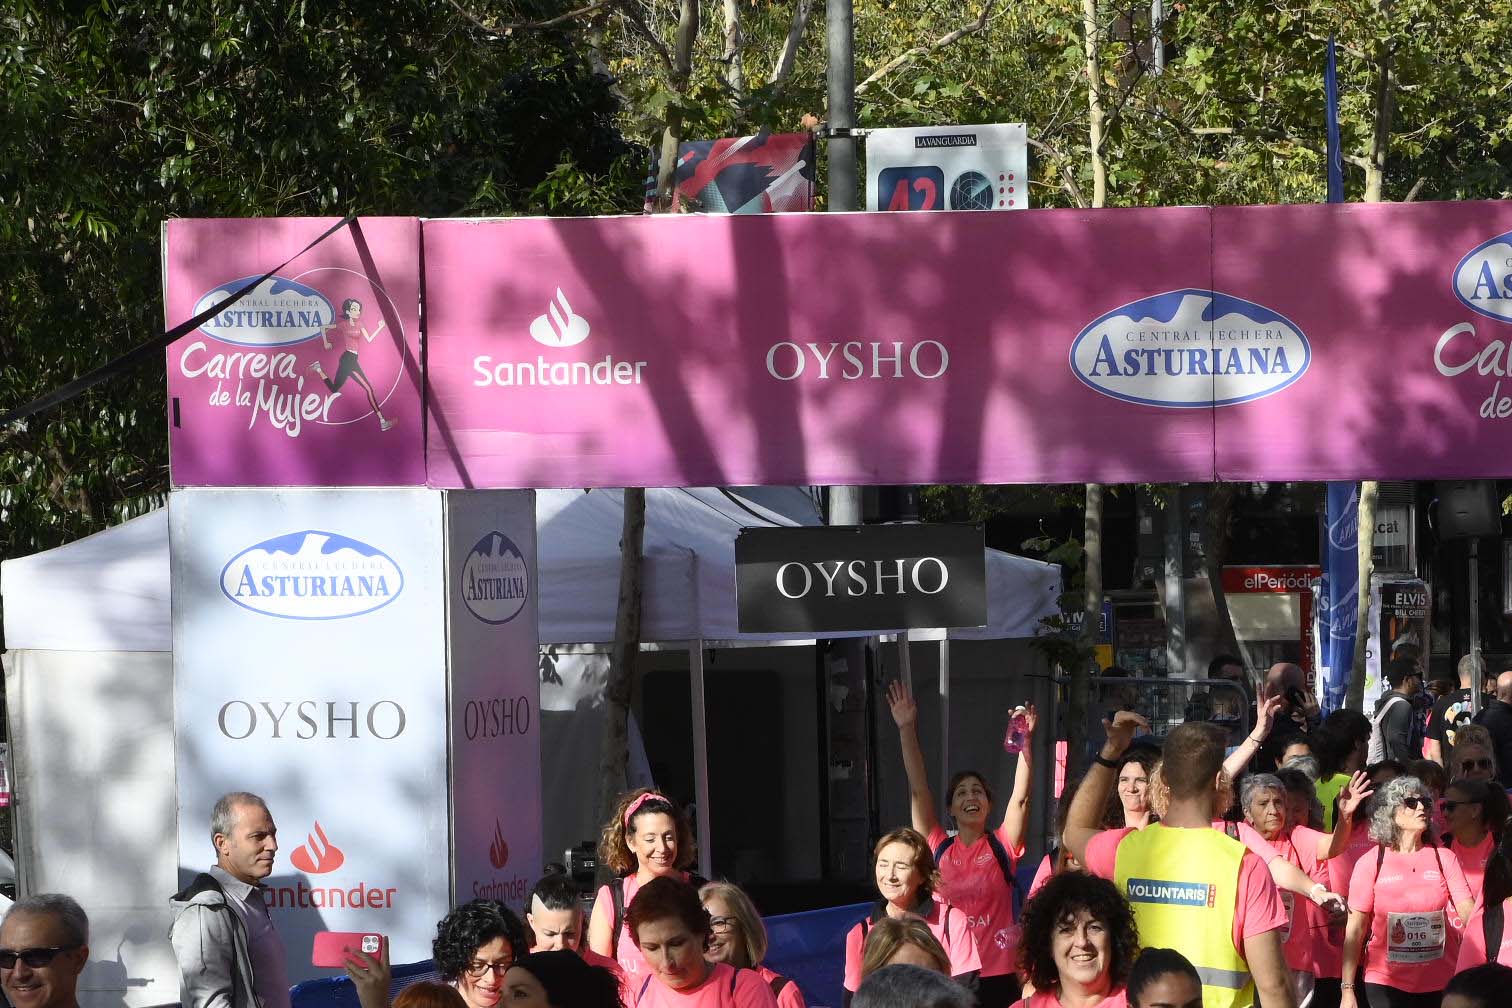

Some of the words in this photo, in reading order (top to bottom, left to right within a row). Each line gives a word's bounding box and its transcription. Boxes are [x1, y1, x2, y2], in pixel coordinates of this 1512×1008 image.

[917, 137, 927, 147] LA
[926, 135, 976, 146] VANGUARDIA
[202, 301, 323, 328] ASTURIANA
[233, 299, 269, 307] ENTRAL
[1126, 329, 1201, 342] CENTRAL
[1209, 329, 1283, 341] LECHERA
[180, 341, 297, 379] Carrera
[473, 354, 648, 386] Santander
[766, 339, 949, 381] OYSHO
[1089, 334, 1292, 377] ASTURIANA
[209, 380, 231, 406] de
[235, 380, 251, 406] la
[249, 375, 342, 438] Mujer
[235, 564, 390, 598] ASTURIANA
[467, 567, 526, 601] ASTURIANA
[776, 557, 949, 599] OYSHO
[1244, 572, 1313, 590] elPeriódi
[1395, 592, 1427, 606] ELVIS
[217, 699, 407, 740] OYSHO
[464, 695, 530, 741] OYSHO
[264, 883, 397, 909] antander
[1128, 884, 1206, 901] VOLUNTARIS
[1406, 931, 1427, 941] 016
